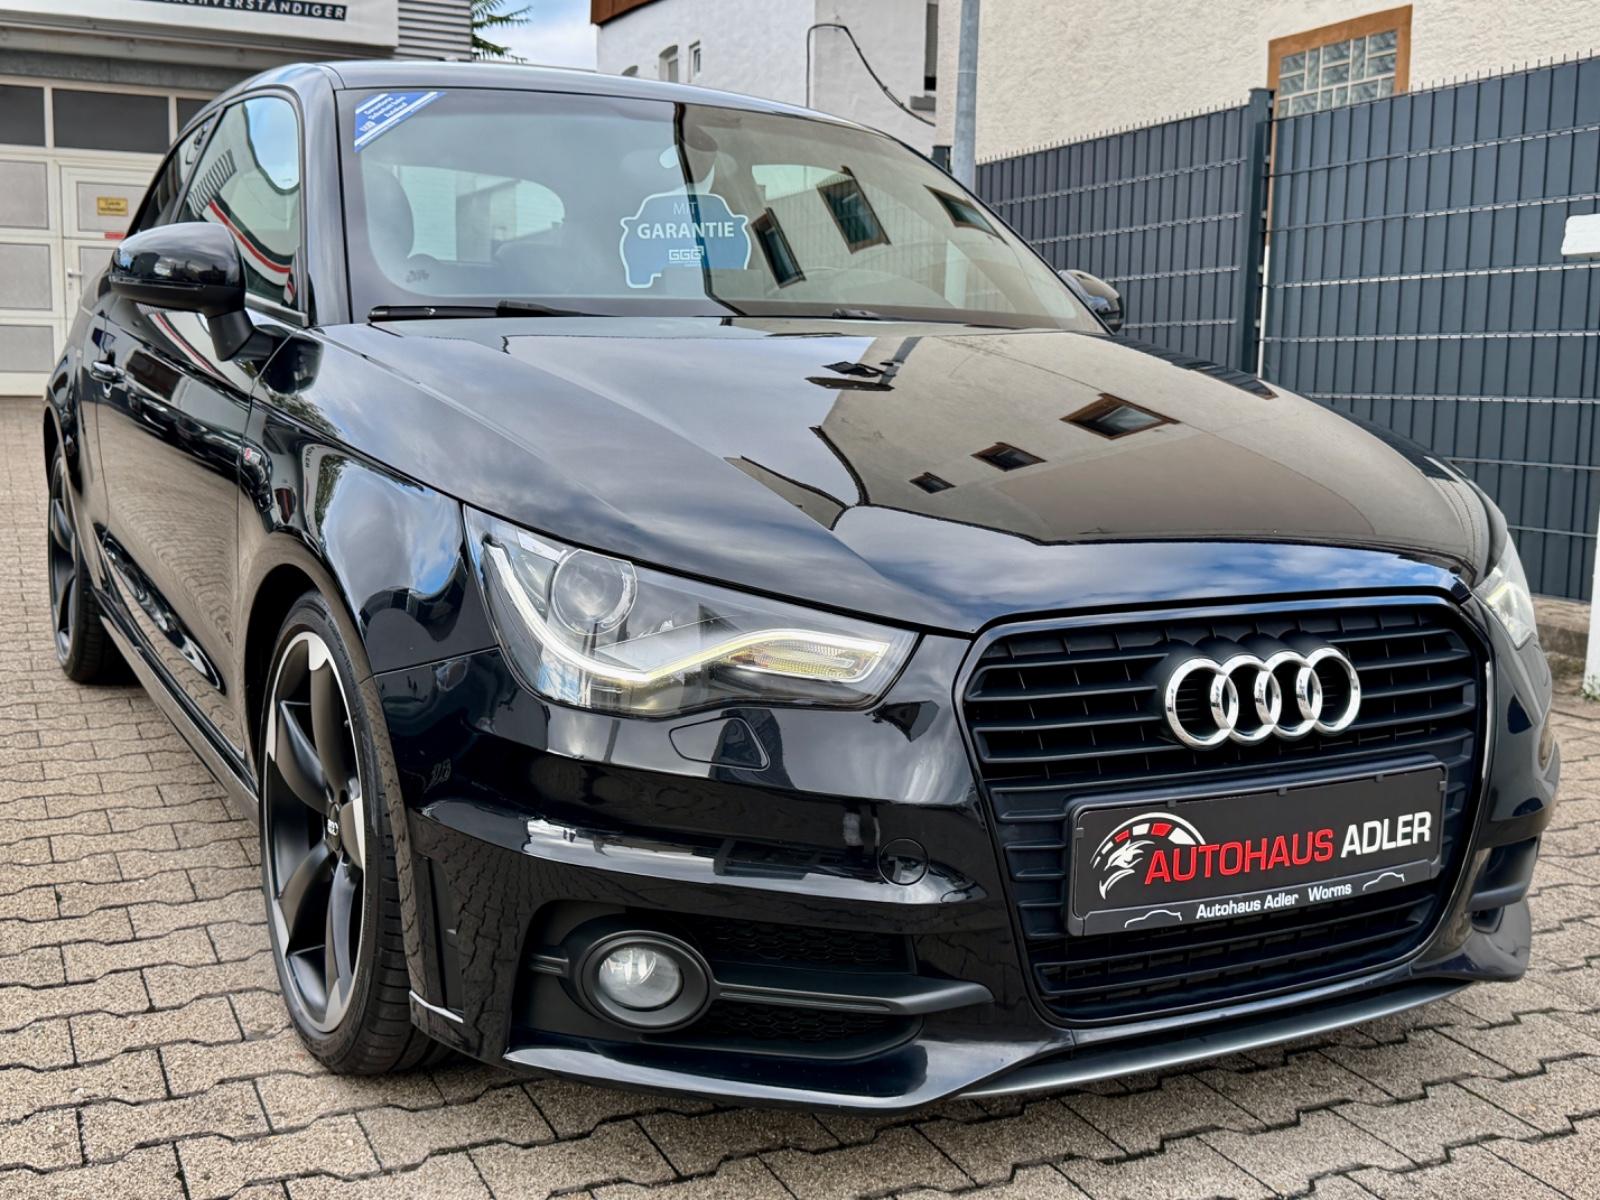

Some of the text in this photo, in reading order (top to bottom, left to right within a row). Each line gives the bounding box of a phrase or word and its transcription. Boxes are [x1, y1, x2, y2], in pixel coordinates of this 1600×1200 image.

[673, 202, 697, 215] MIT
[637, 222, 735, 239] GARANTIE
[1144, 811, 1432, 885] AUTOHAUS ADLER
[1196, 883, 1352, 920] Autohaus Adler Worms
